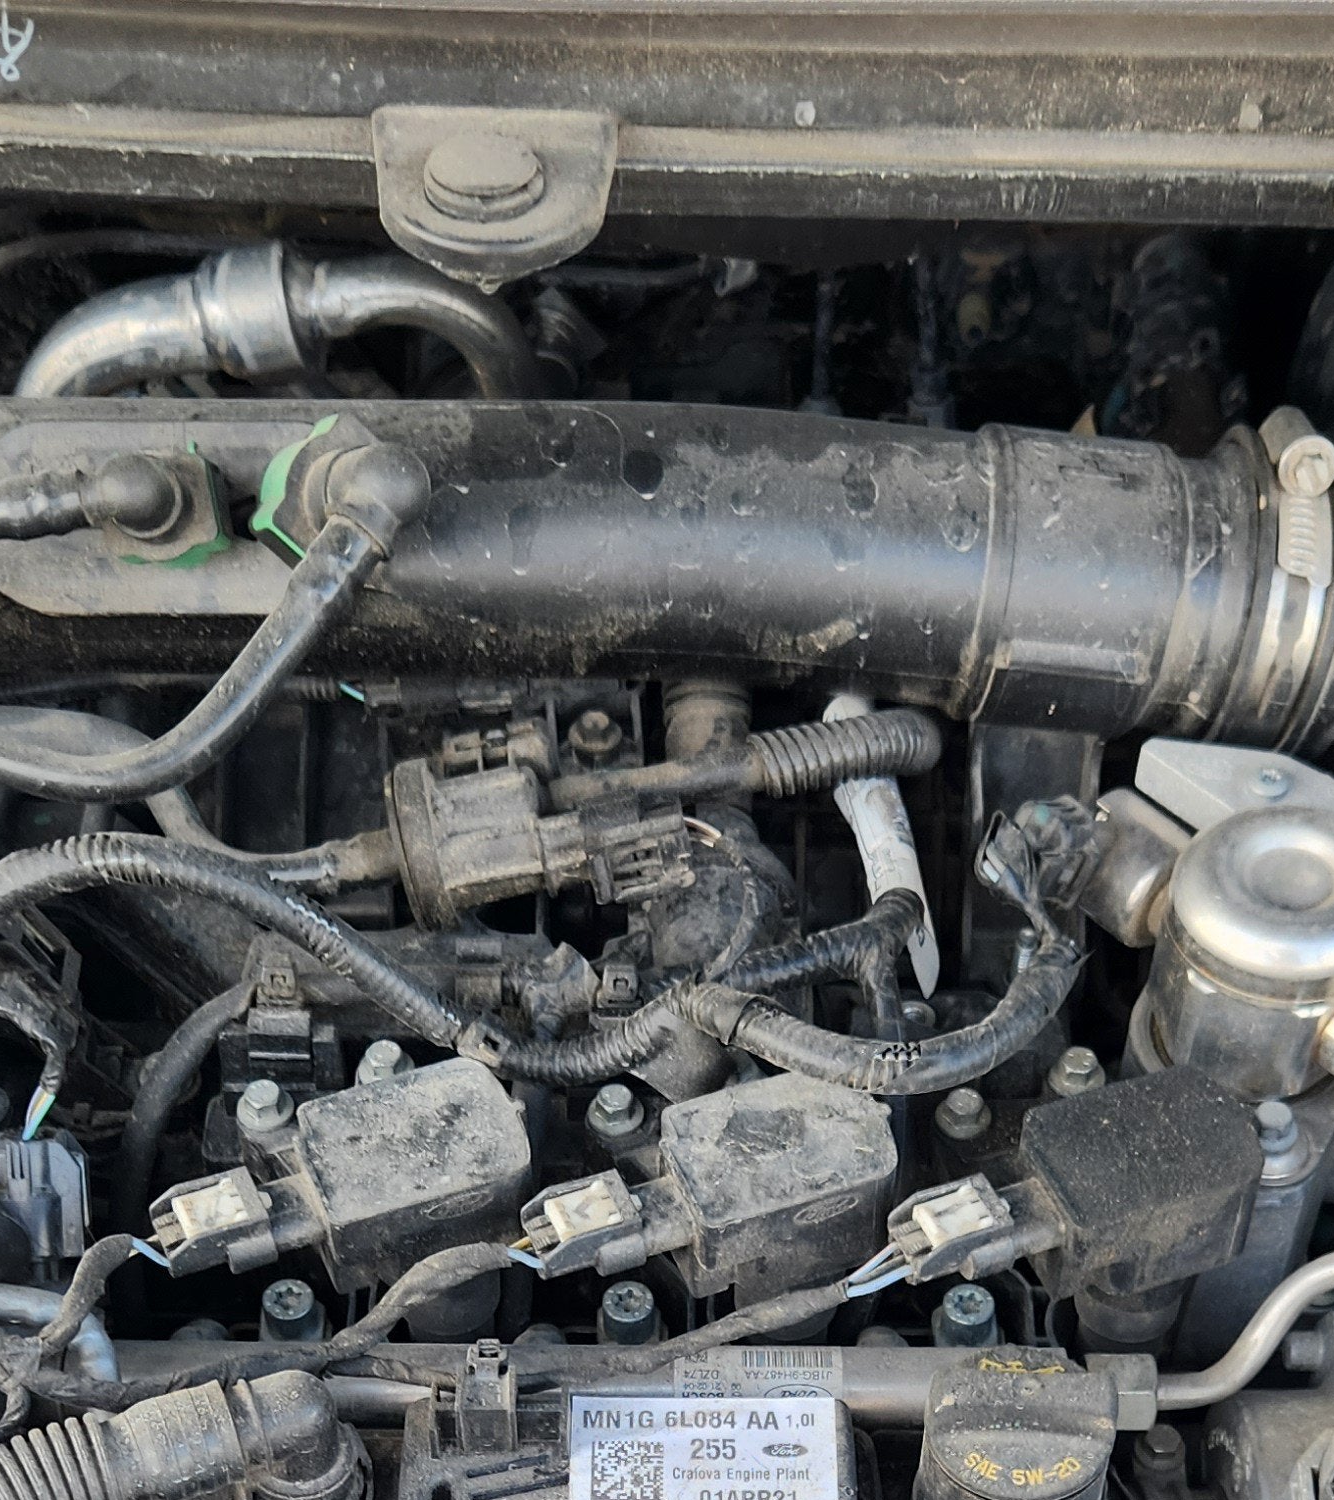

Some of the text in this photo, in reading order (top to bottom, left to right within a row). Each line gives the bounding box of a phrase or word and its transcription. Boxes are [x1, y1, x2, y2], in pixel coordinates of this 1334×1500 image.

[583, 1410, 654, 1429] MN1G
[665, 1410, 737, 1429] 6L084
[746, 1411, 779, 1430] AA
[690, 1438, 736, 1460] 255
[768, 1443, 804, 1457] Ford
[672, 1467, 810, 1482] Craiova Engine Plant
[963, 1452, 1082, 1486] SAE 5W-20
